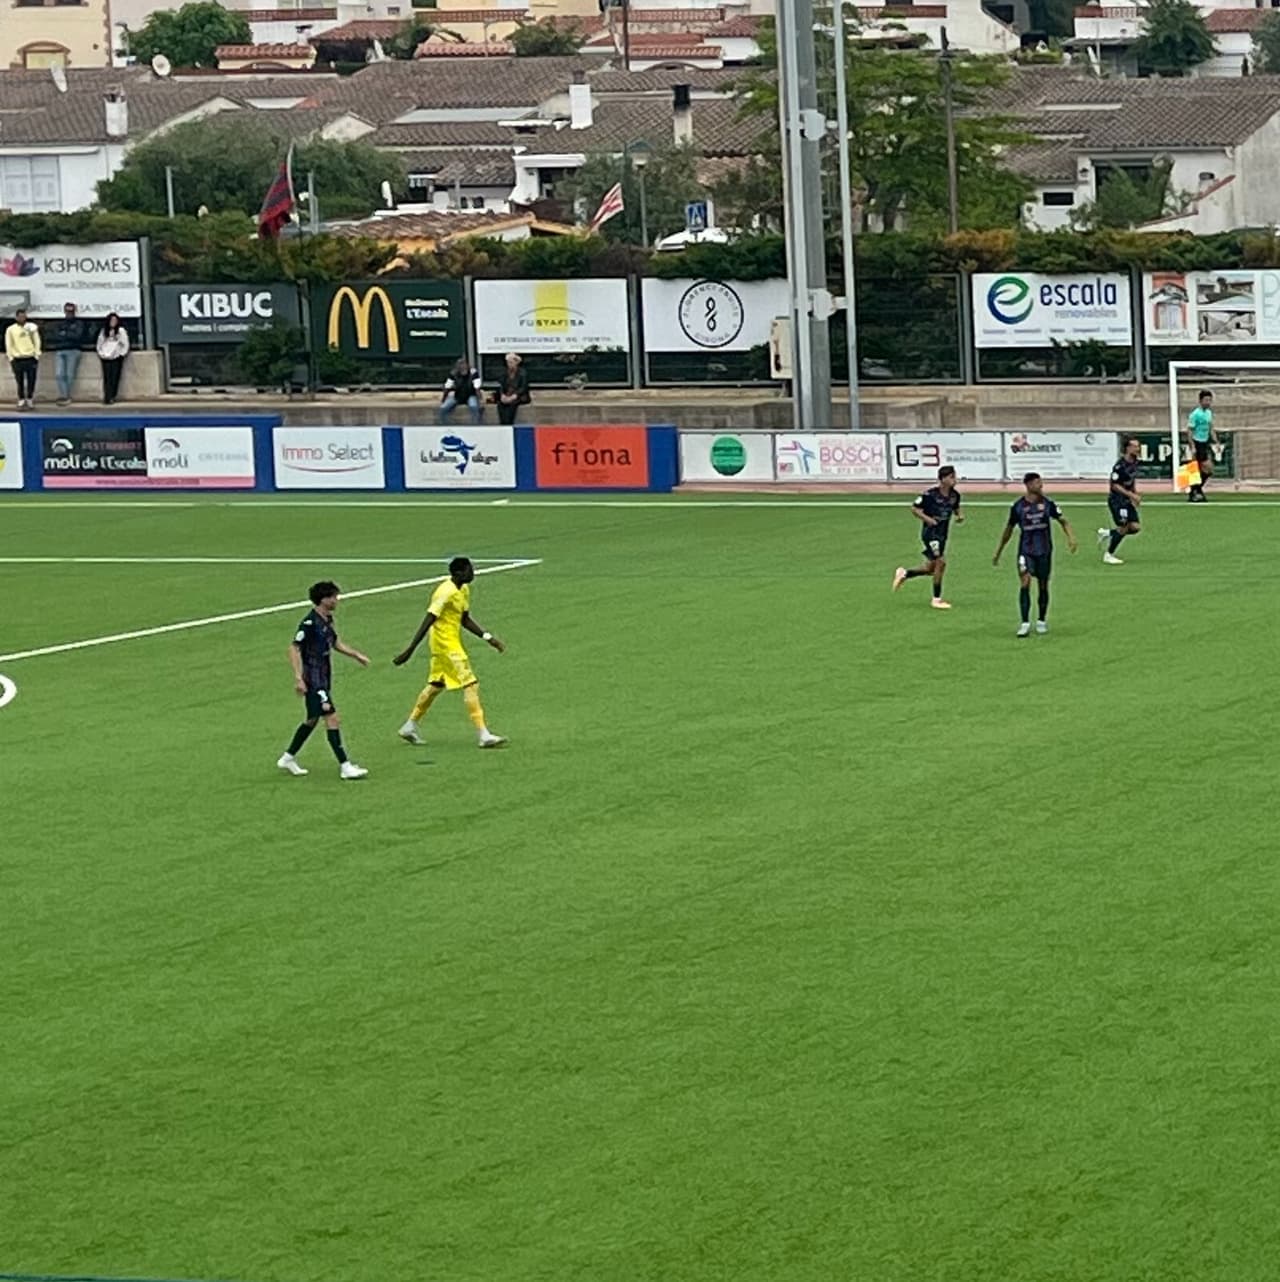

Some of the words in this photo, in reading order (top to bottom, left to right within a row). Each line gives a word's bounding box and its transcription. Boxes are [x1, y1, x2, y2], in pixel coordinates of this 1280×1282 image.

[43, 257, 132, 273] K3HOMES
[1040, 277, 1117, 305] escala
[180, 292, 273, 319] KIBUC
[281, 444, 324, 461] Immo
[329, 442, 375, 461] Select
[552, 442, 632, 466] fiona
[820, 446, 884, 463] BOSCH
[82, 456, 98, 469] de
